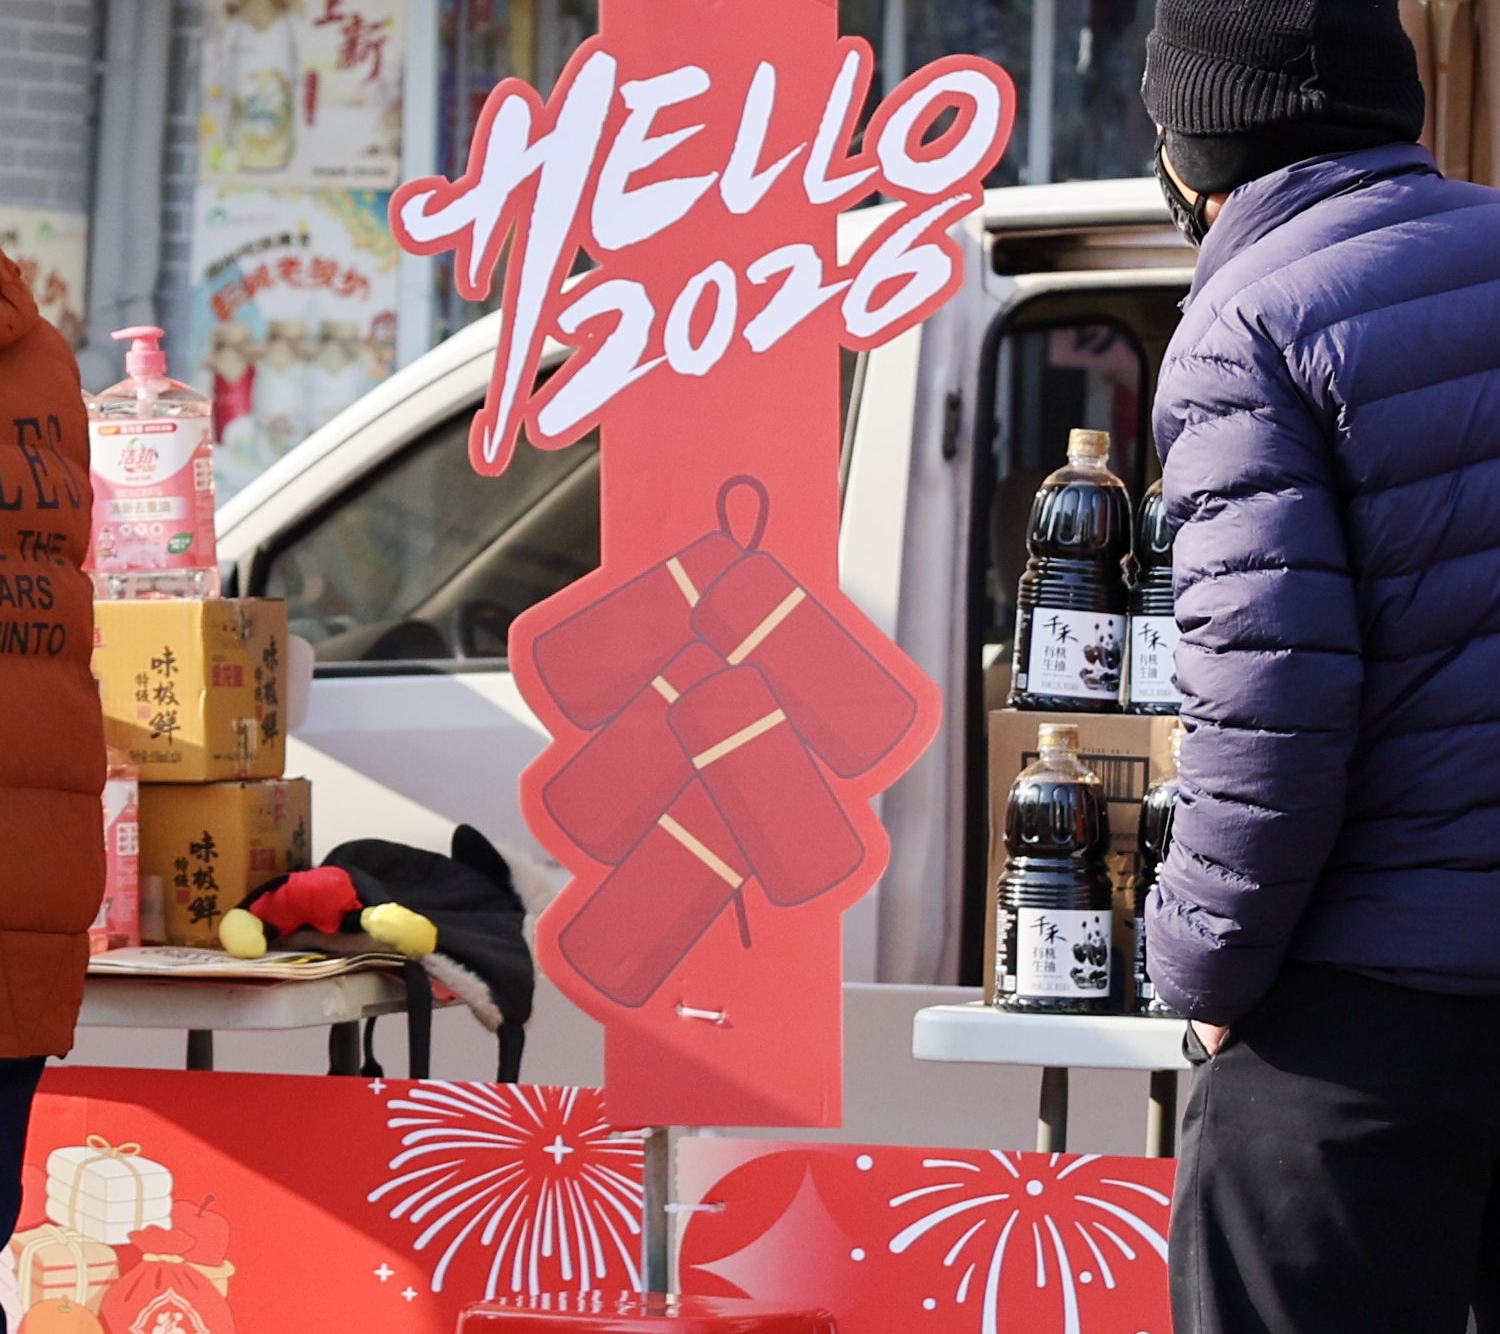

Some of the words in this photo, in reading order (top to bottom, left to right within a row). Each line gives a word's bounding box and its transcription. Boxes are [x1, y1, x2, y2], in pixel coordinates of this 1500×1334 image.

[400, 50, 1001, 465] HELLO
[536, 192, 974, 438] 2026
[16, 529, 68, 566] THE
[1042, 614, 1079, 645] 千禾
[1137, 621, 1168, 651] 千禾
[149, 645, 181, 746] 味极鲜
[188, 829, 221, 930] 味极鲜
[1028, 913, 1068, 947] 千禾
